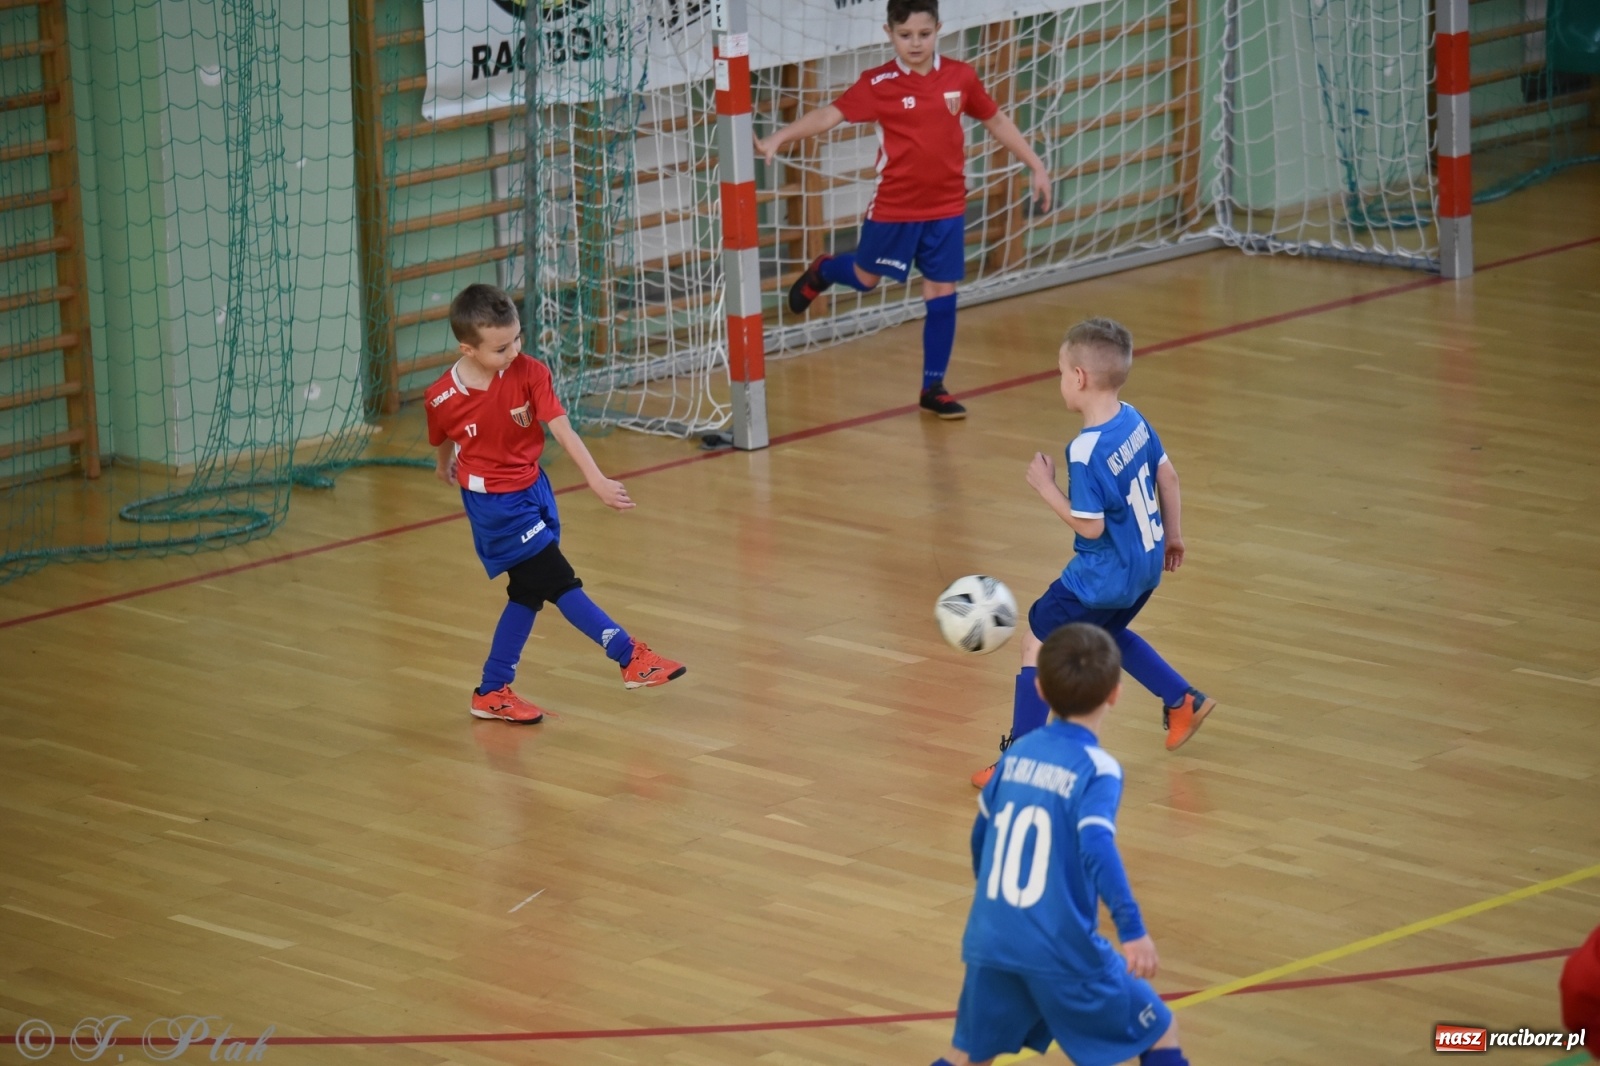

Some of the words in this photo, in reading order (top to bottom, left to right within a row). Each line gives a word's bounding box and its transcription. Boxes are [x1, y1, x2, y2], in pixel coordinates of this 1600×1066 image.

[902, 96, 916, 109] 19
[464, 423, 478, 438] 17
[520, 519, 547, 544] LEGE
[986, 801, 1052, 908] 10
